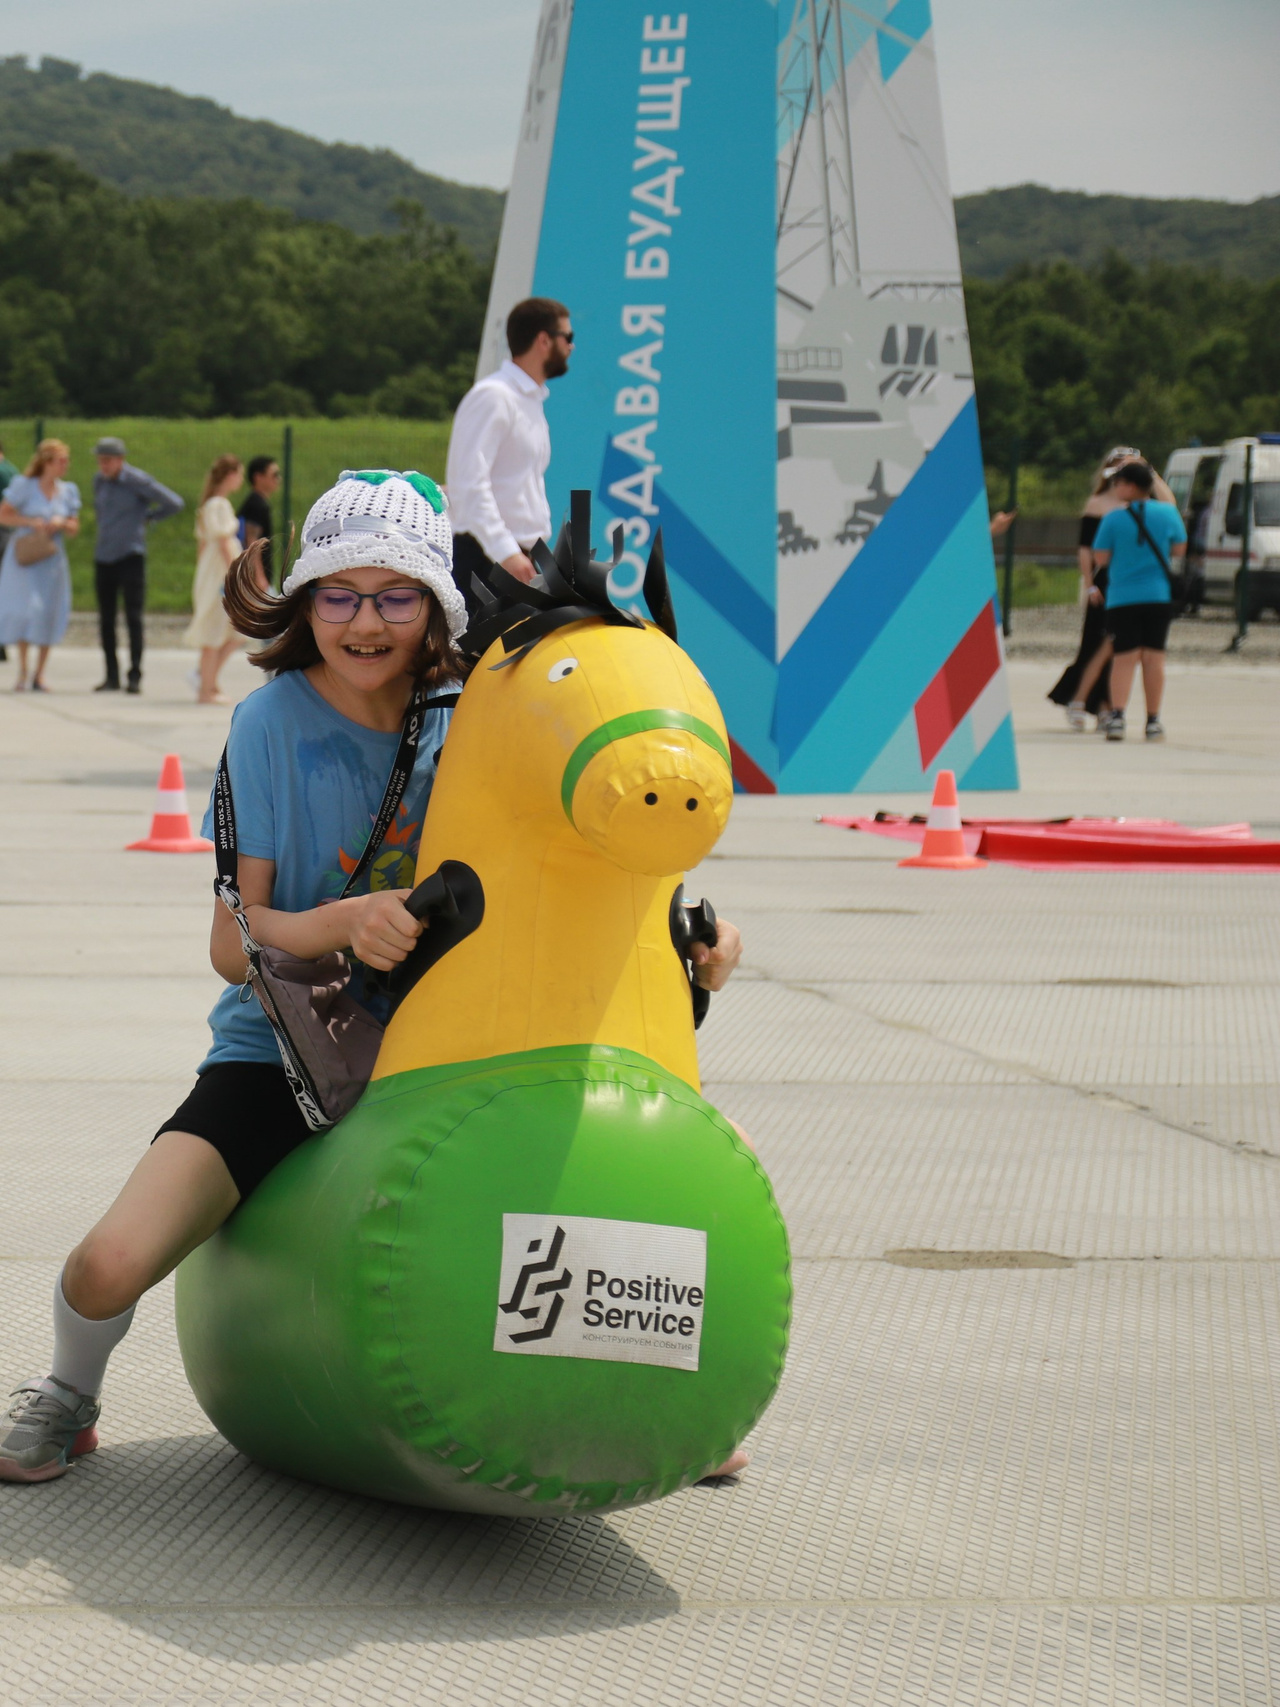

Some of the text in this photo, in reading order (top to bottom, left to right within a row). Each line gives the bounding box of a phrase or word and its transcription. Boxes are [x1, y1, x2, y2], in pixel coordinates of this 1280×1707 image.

[605, 13, 692, 617] ОЗДАВАЯ БУДУЩЕЕ
[586, 1269, 704, 1308] Positive
[582, 1299, 696, 1337] Service
[582, 1333, 693, 1351] КОНСТРУИРУЕМ СОБЫТИЯ
